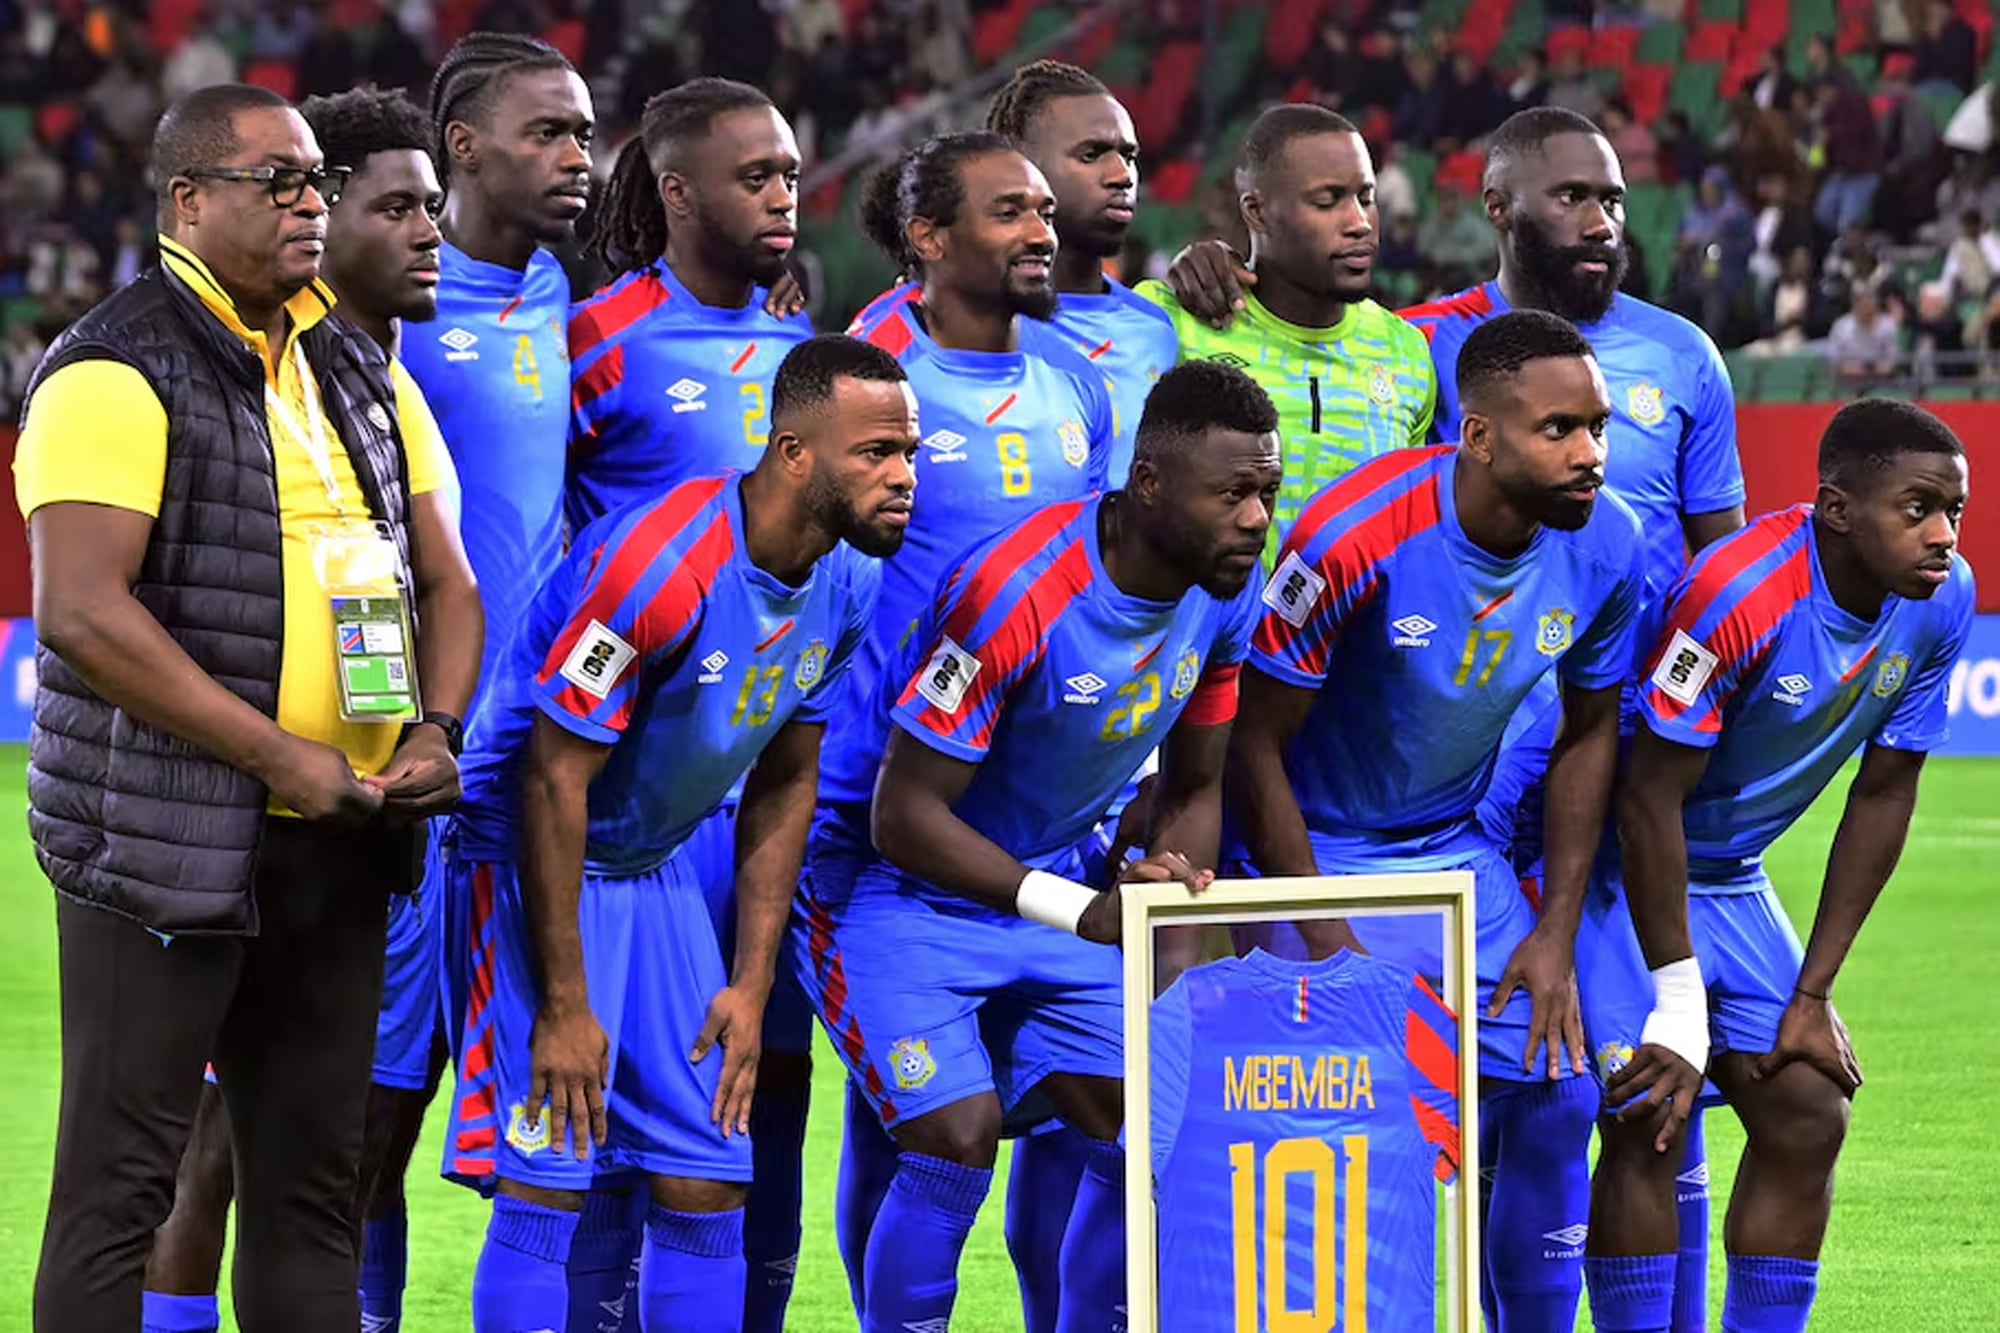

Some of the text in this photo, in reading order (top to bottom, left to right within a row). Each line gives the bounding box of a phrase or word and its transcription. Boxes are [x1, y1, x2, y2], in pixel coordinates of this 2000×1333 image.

[513, 334, 543, 400] 4
[740, 382, 769, 445] 2
[1309, 376, 1322, 434] 1
[996, 432, 1031, 495] 8
[1393, 636, 1431, 648] umbro
[1454, 629, 1514, 688] 17
[730, 665, 784, 726] 13
[1101, 672, 1161, 741] 22
[1223, 1055, 1376, 1112] MBEMBA
[1228, 1134, 1369, 1333] 101
